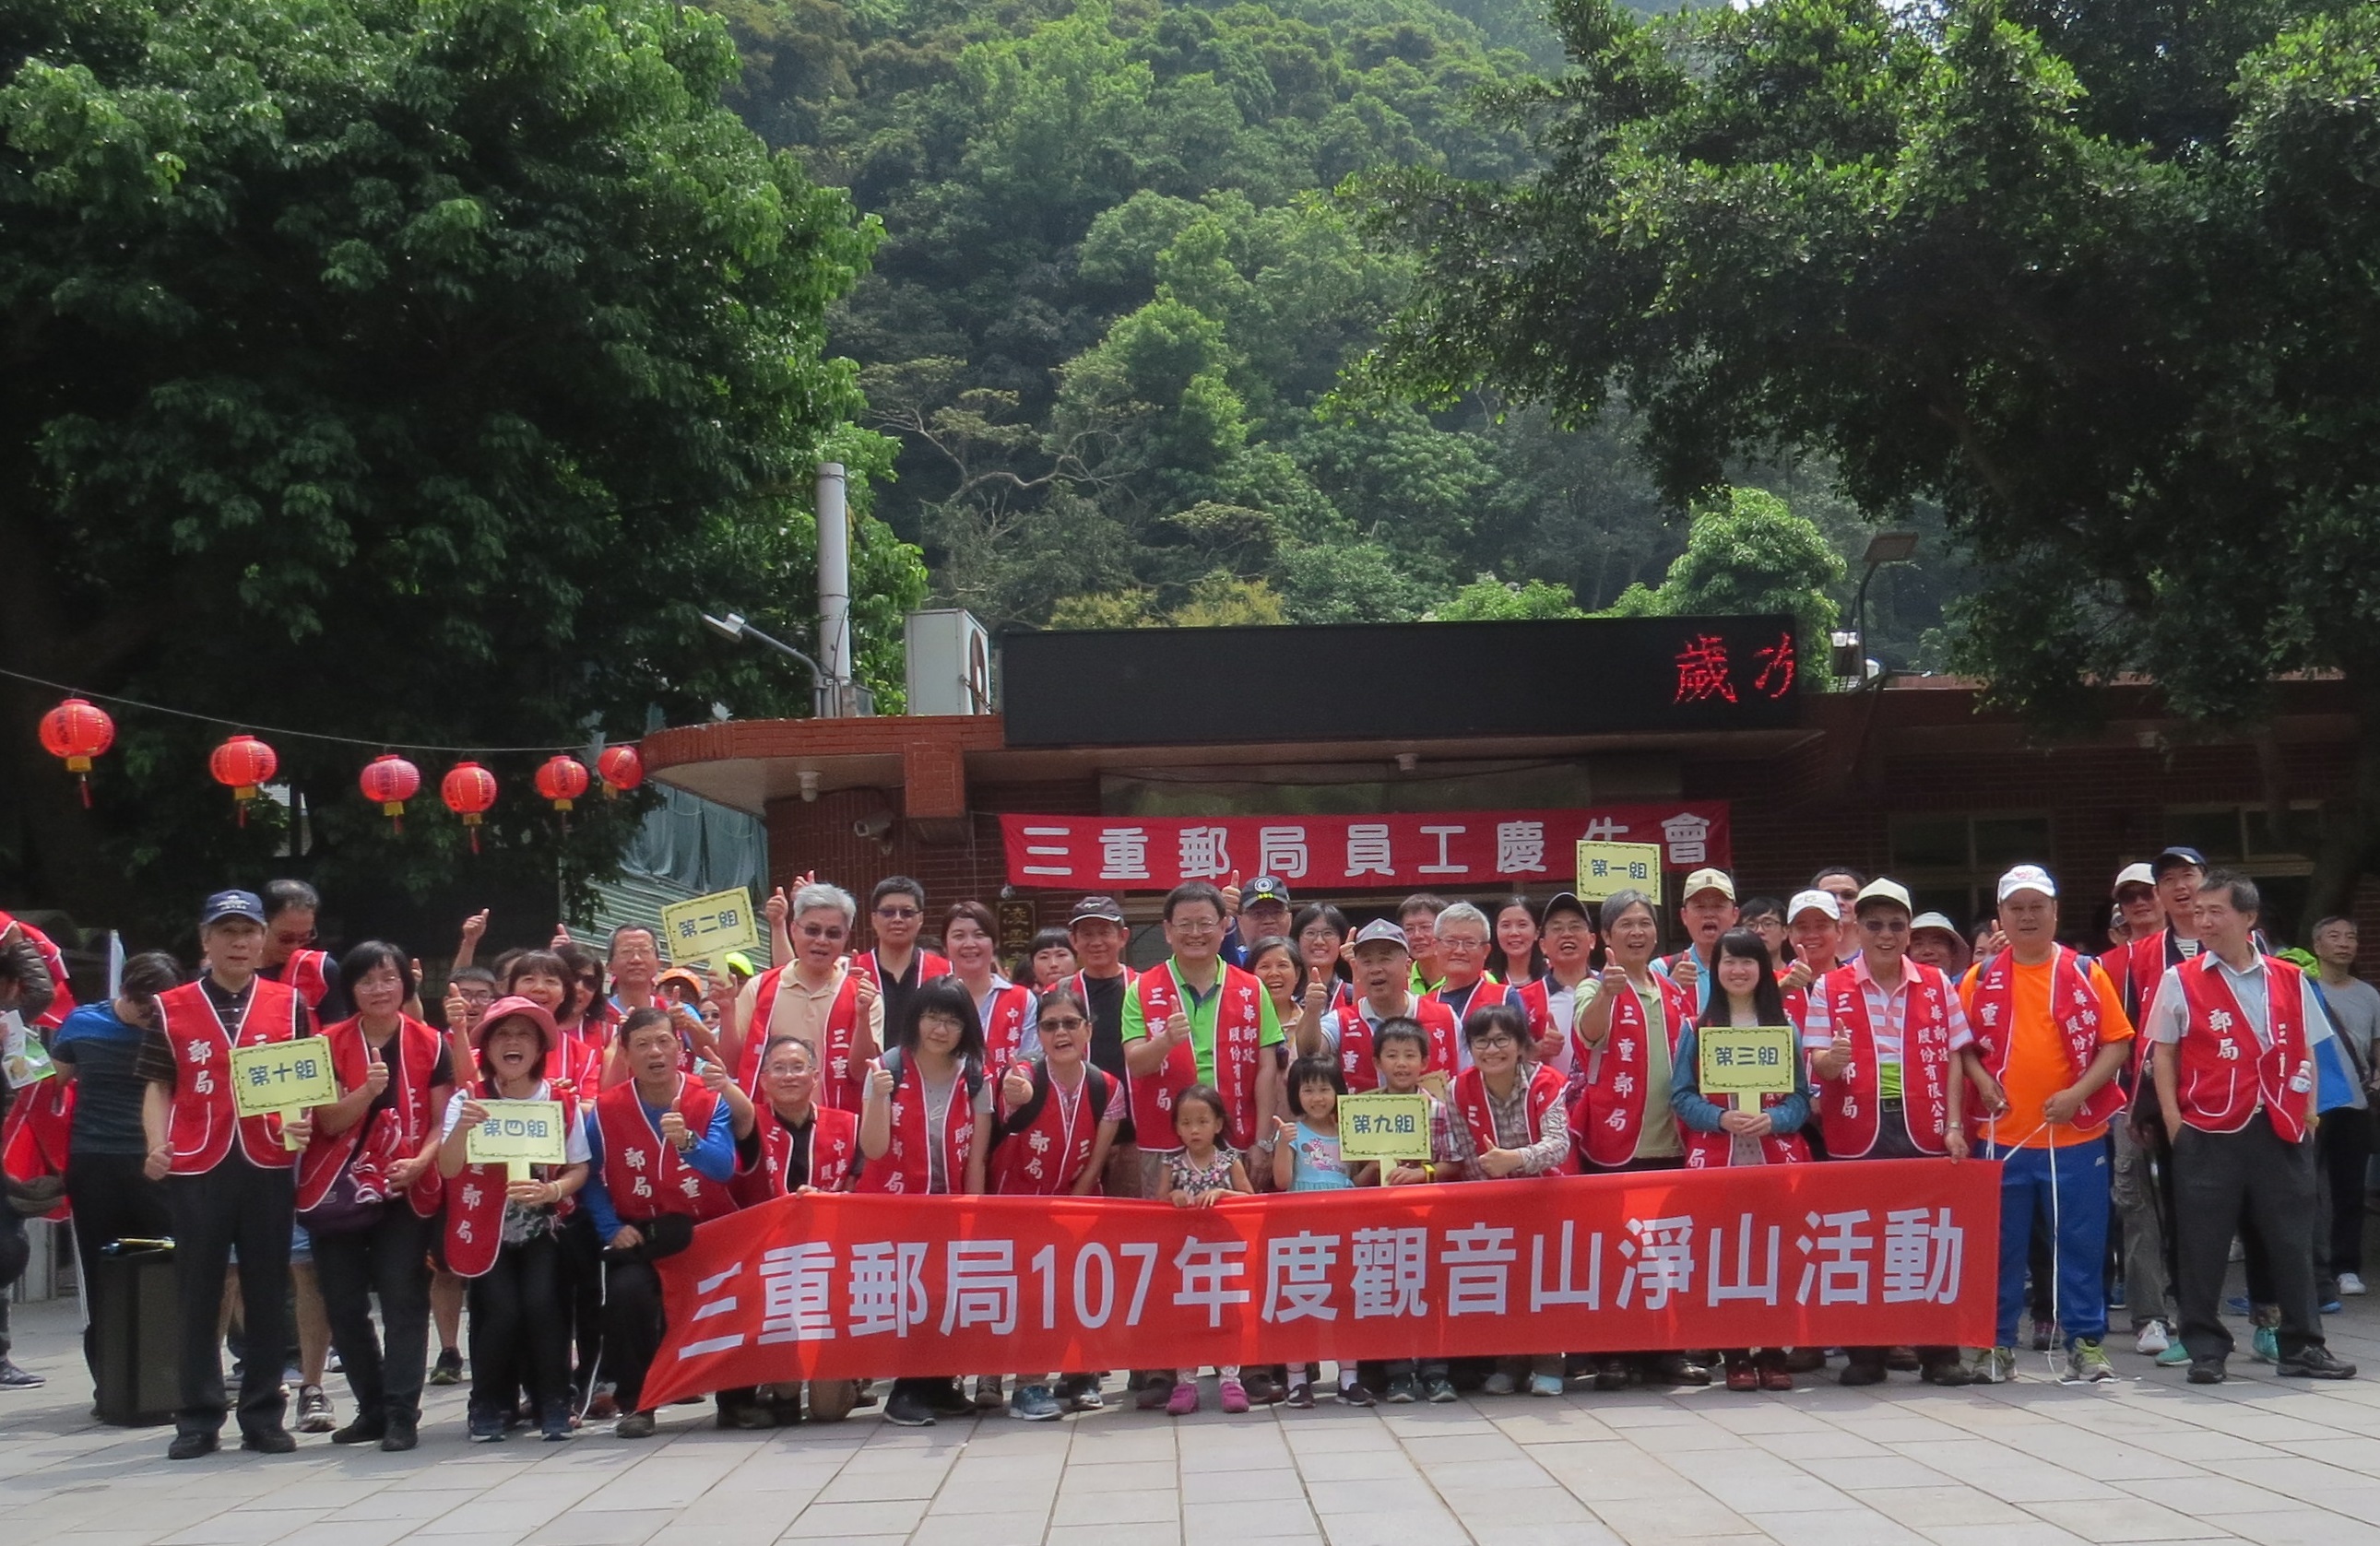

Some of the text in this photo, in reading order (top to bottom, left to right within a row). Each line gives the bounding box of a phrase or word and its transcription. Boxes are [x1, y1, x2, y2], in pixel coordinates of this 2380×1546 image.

[1591, 858, 1648, 880] 第一組
[678, 909, 740, 938] 第二組
[1238, 986, 1258, 1064] 中華郵政
[1924, 987, 1948, 1062] 中華郵政
[2208, 1009, 2240, 1060] 郵局
[187, 1038, 214, 1095] 郵局
[248, 1058, 319, 1087] 第十組
[831, 1028, 850, 1080] 三重
[1604, 1005, 1639, 1132] 三重郵局
[1714, 1045, 1780, 1067] 第三組
[1917, 1027, 1945, 1136] 股份有限公司
[483, 1117, 549, 1139] 第四組
[1352, 1114, 1415, 1134] 第九組
[624, 1147, 653, 1198] 郵局
[1024, 1130, 1051, 1180] 郵局
[678, 1207, 1964, 1362] 三重郵局107年度觀音山淨山活動
